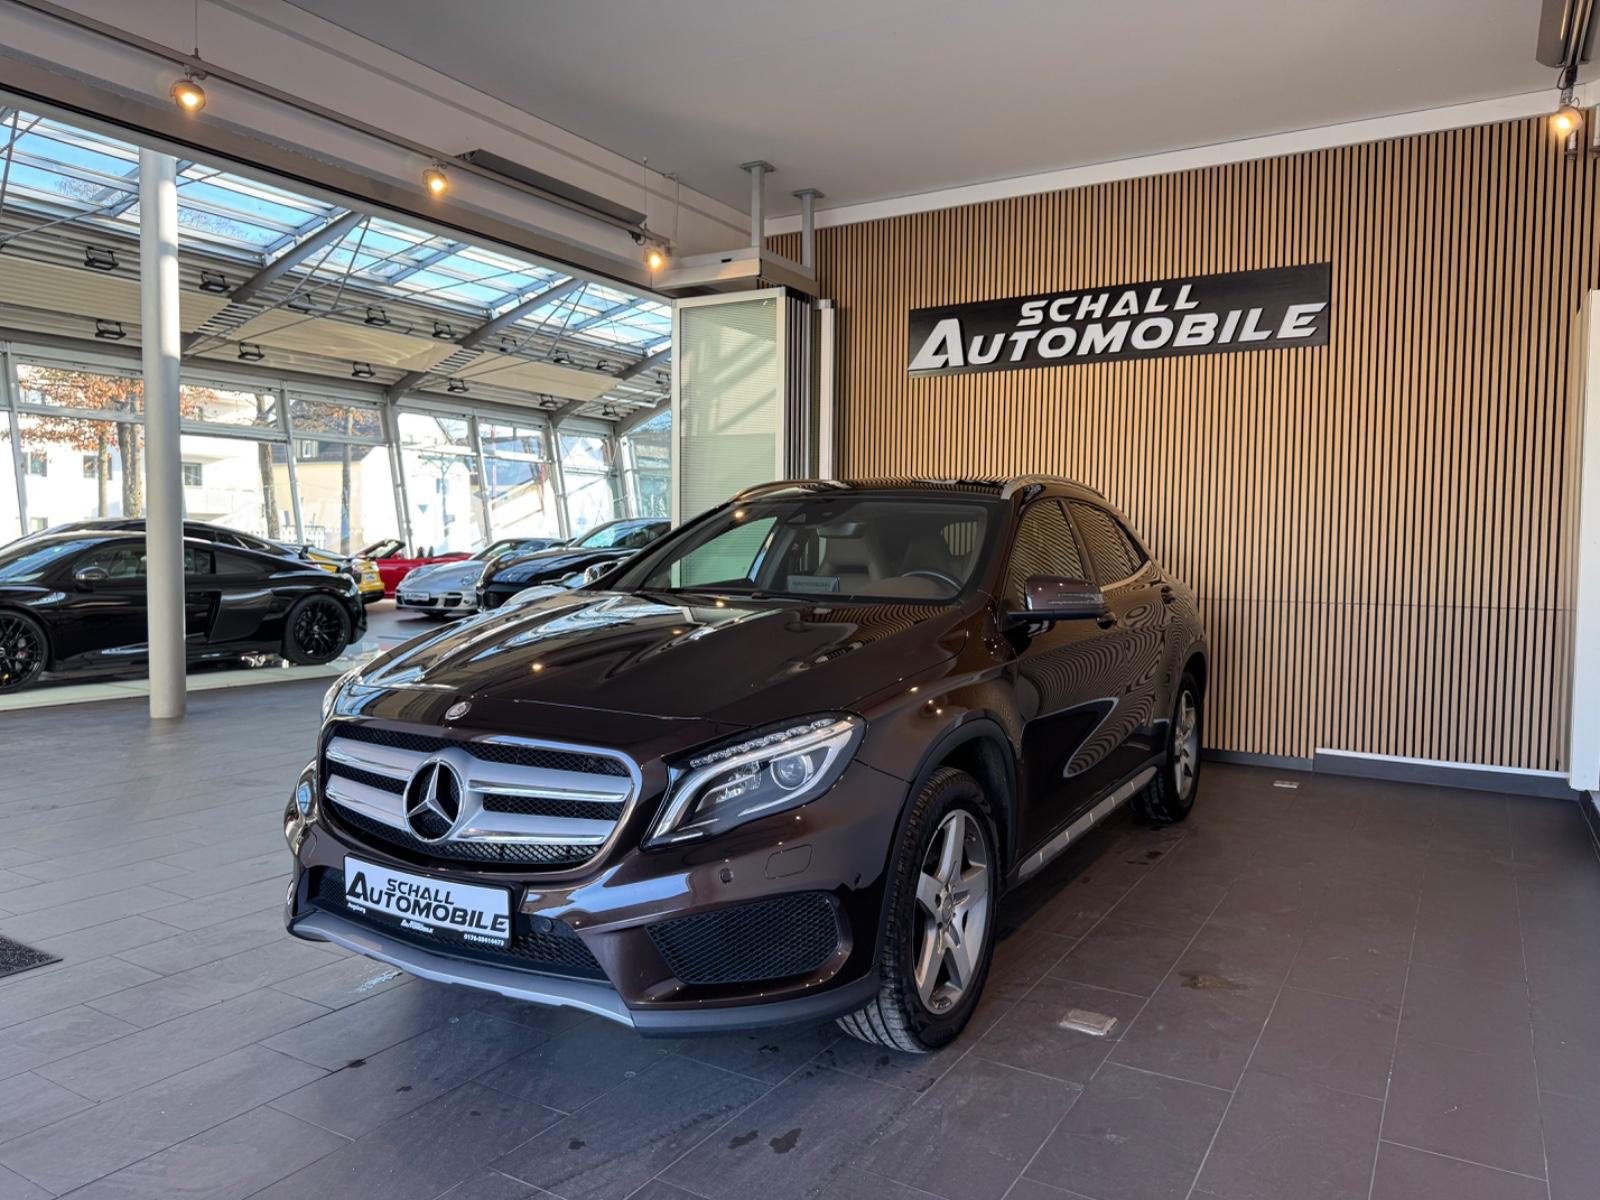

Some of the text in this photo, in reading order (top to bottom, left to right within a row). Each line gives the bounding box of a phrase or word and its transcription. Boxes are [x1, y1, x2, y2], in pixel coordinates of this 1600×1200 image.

[1016, 284, 1199, 326] SCHALL
[907, 302, 1328, 371] AUTOMOBILE
[346, 871, 509, 932] AUTOMOBILE
[386, 878, 455, 905] SCHALL
